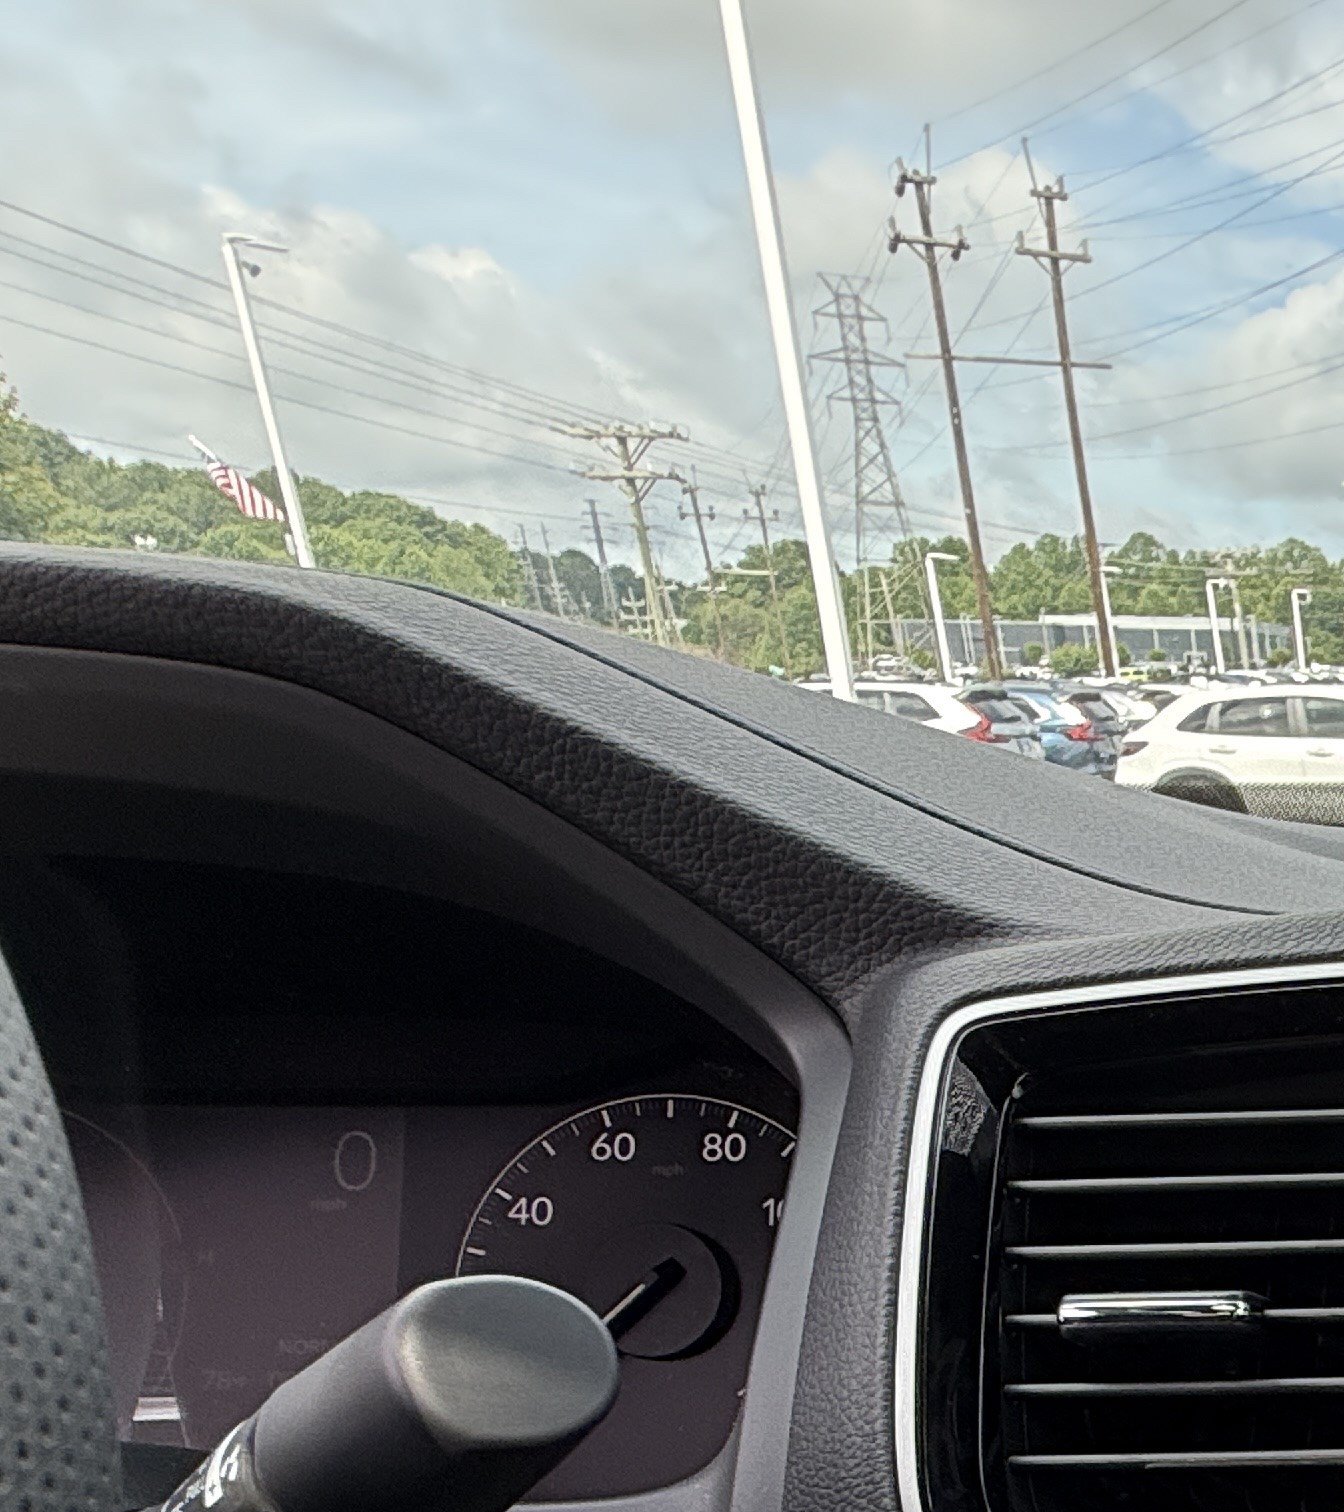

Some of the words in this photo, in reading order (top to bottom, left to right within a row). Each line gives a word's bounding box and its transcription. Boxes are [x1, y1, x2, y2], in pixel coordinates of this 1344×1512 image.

[590, 1132, 636, 1162] 60
[702, 1132, 747, 1162] 80
[507, 1197, 554, 1226] 40
